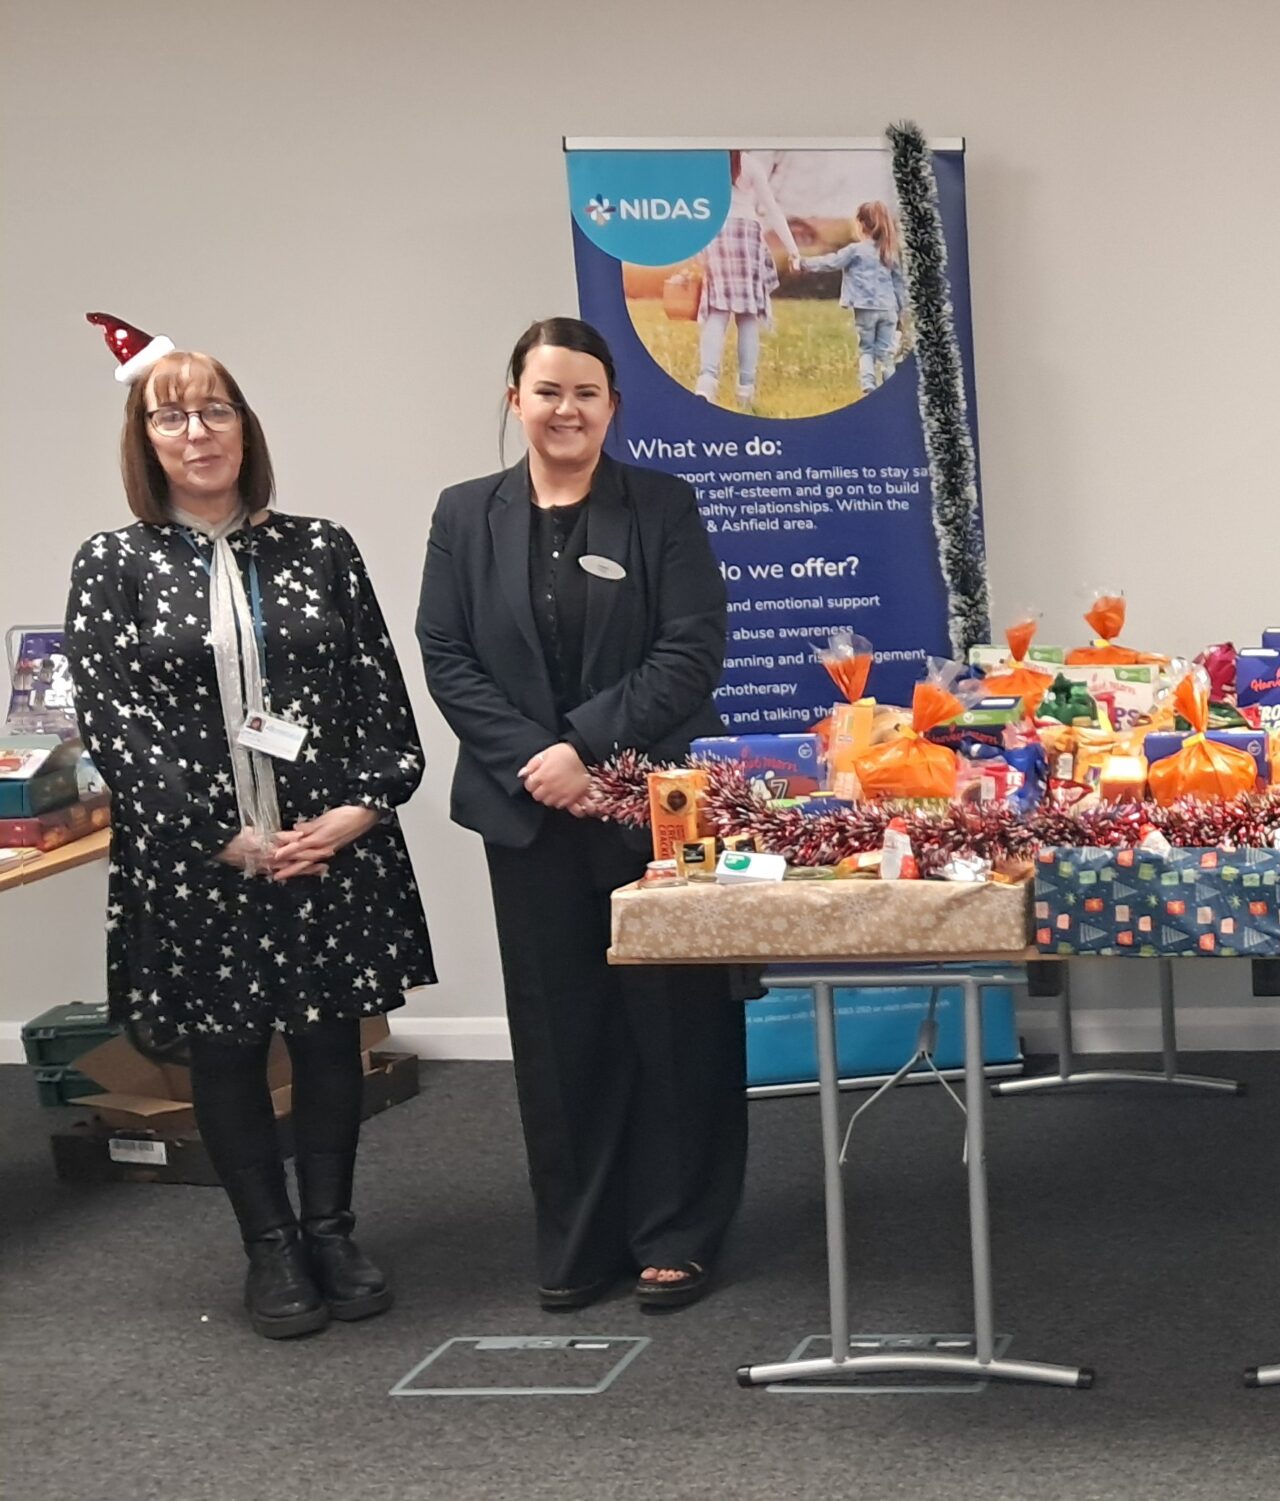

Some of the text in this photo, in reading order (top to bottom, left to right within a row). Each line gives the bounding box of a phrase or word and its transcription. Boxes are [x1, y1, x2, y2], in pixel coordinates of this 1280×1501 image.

[619, 197, 711, 221] NIDAS
[627, 435, 783, 460] What we do:
[719, 470, 772, 482] women
[776, 467, 802, 481] and
[806, 466, 859, 480] families
[862, 466, 877, 478] to
[880, 466, 909, 480] stay
[708, 485, 792, 500] self-esteem
[796, 483, 822, 497] and
[825, 485, 844, 499] go
[847, 484, 864, 495] on
[868, 483, 882, 494] to
[885, 481, 920, 494] build
[741, 499, 833, 516] relationships.
[836, 498, 883, 513] Within
[886, 498, 910, 511] the
[706, 517, 818, 533] & Ashfield area.
[747, 563, 784, 580] we
[790, 555, 860, 579] offer?
[726, 594, 881, 614] and emotional support
[732, 626, 775, 641] abuse
[778, 624, 854, 639] awareness
[723, 654, 774, 669] lanning
[778, 652, 805, 666] and
[733, 708, 759, 723] and
[763, 707, 810, 722] talking
